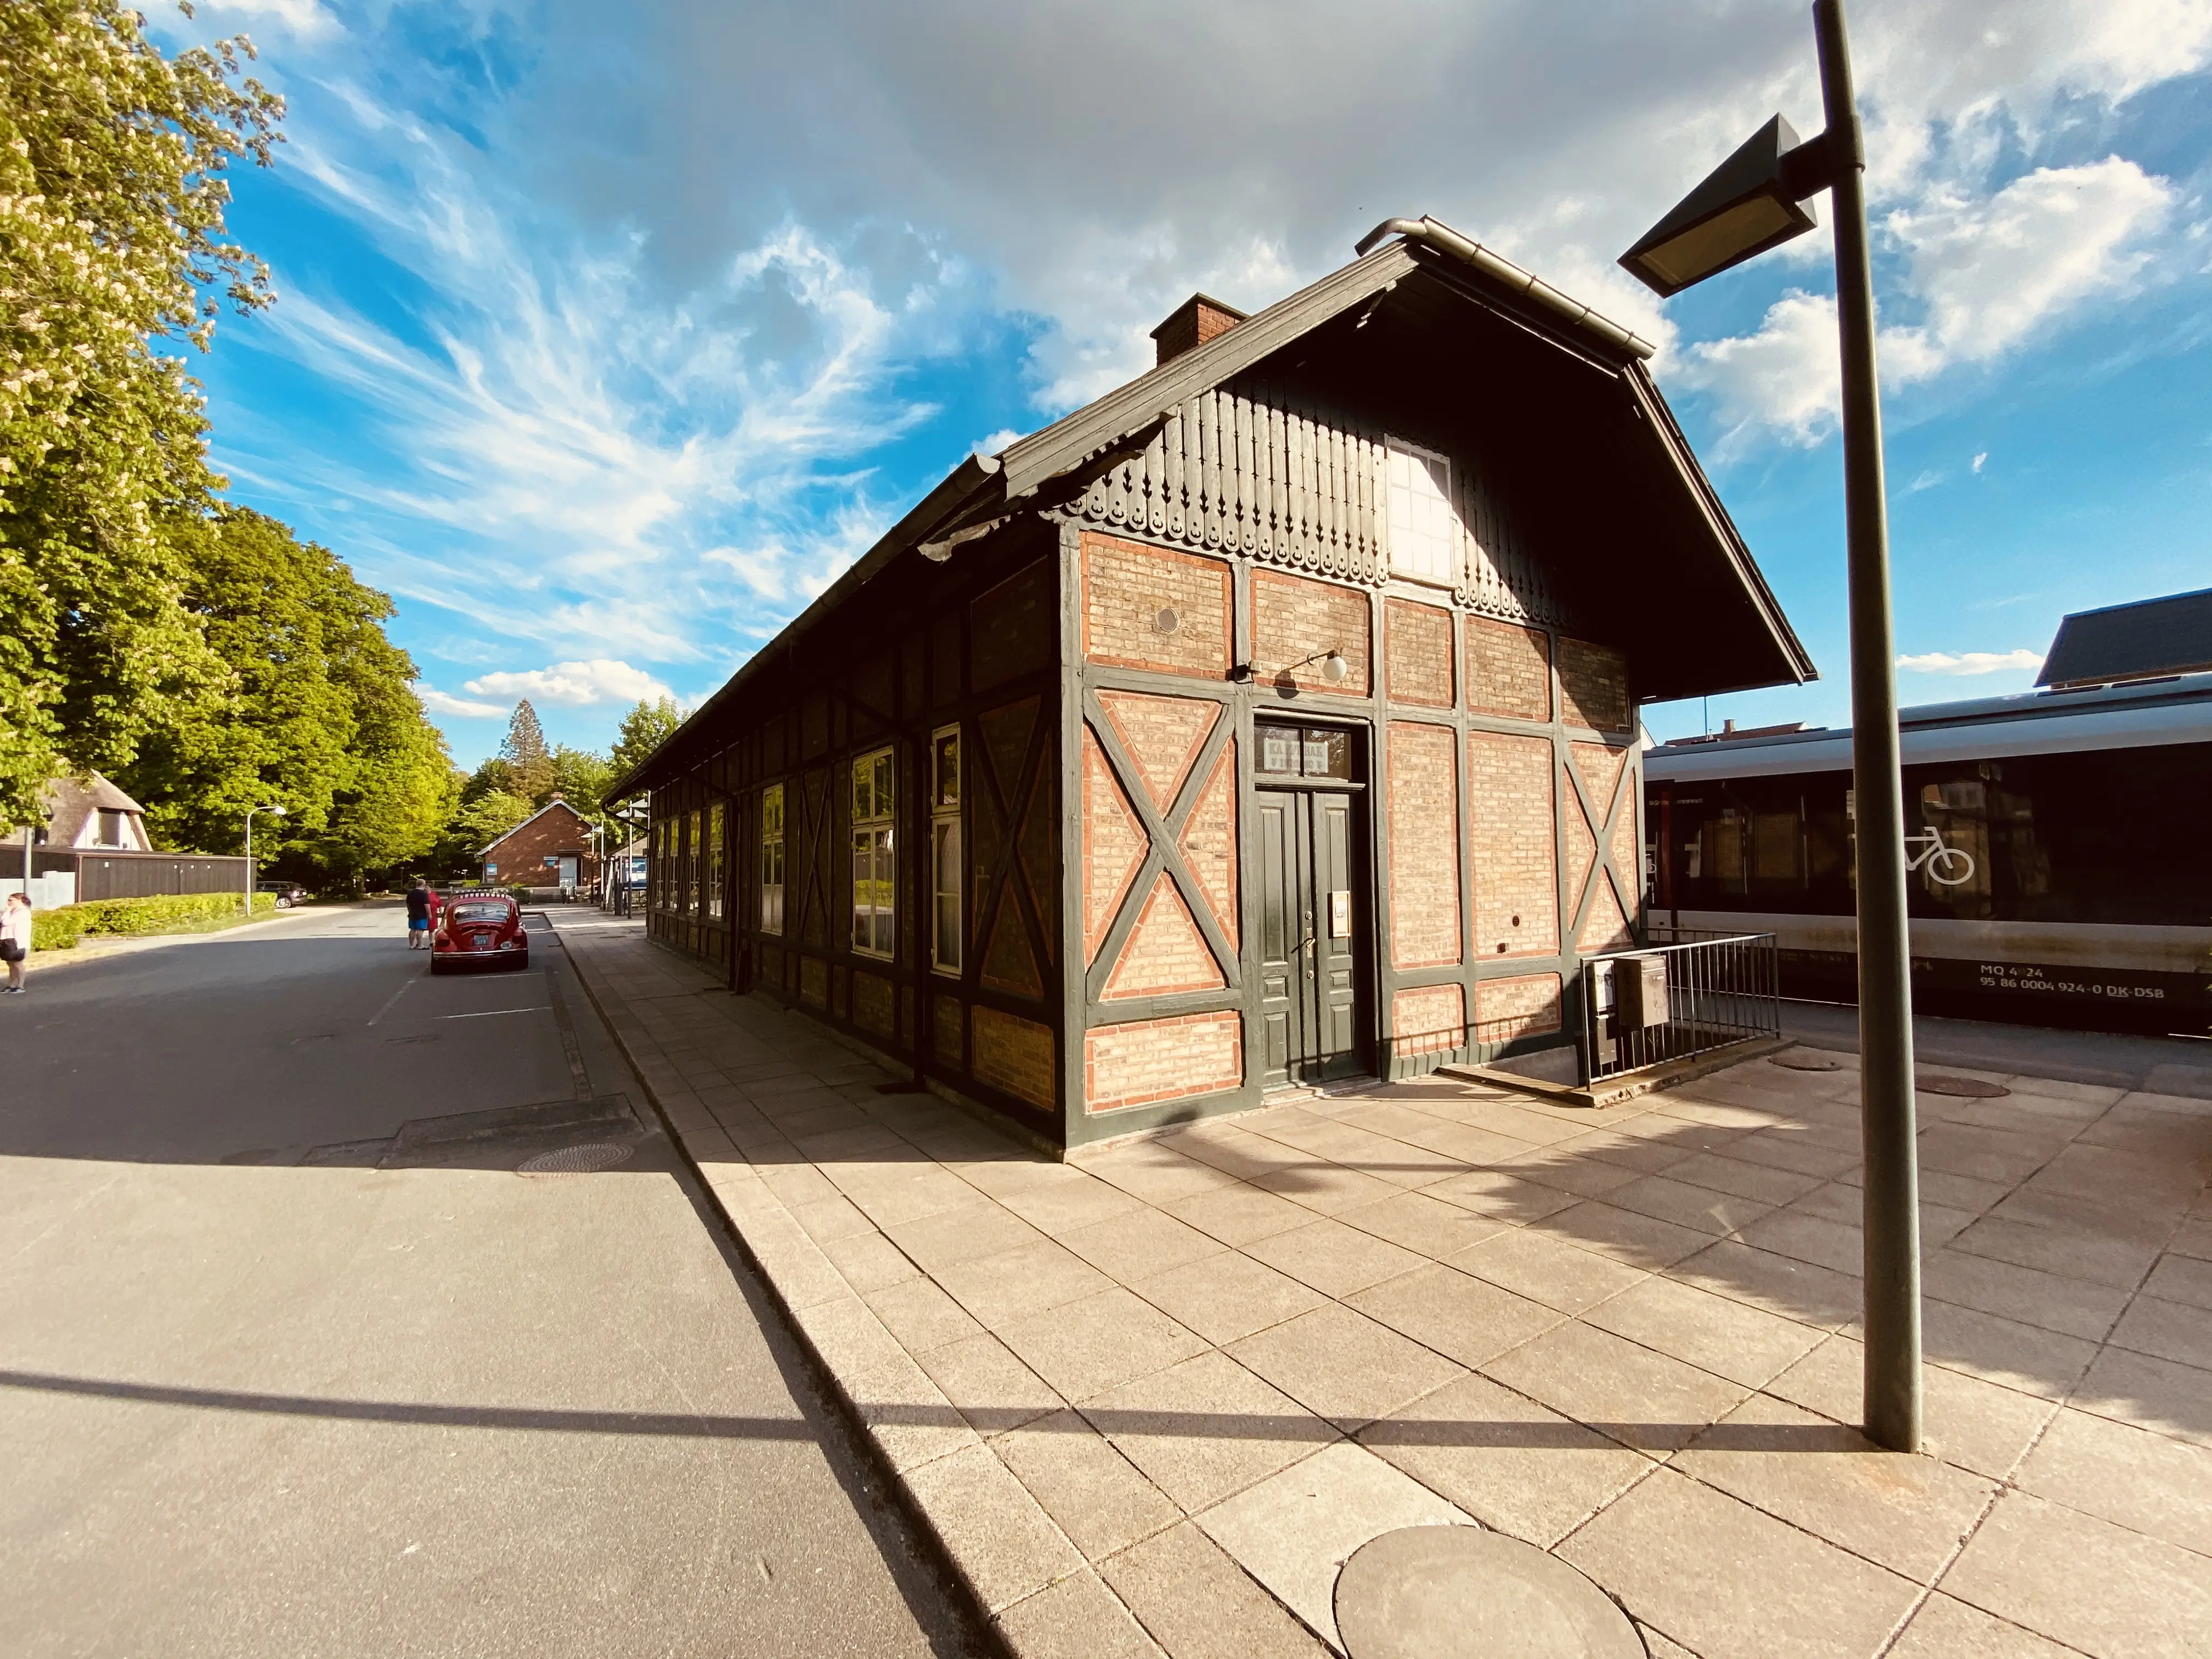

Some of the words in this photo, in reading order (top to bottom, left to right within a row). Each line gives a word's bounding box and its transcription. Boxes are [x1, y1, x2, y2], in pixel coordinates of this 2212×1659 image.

[1980, 964, 2005, 976] MQ
[1979, 977, 1995, 986] 95
[2020, 980, 2054, 991] 0004
[2058, 982, 2102, 994] 924-0
[2107, 985, 2165, 998] DK-DSB
